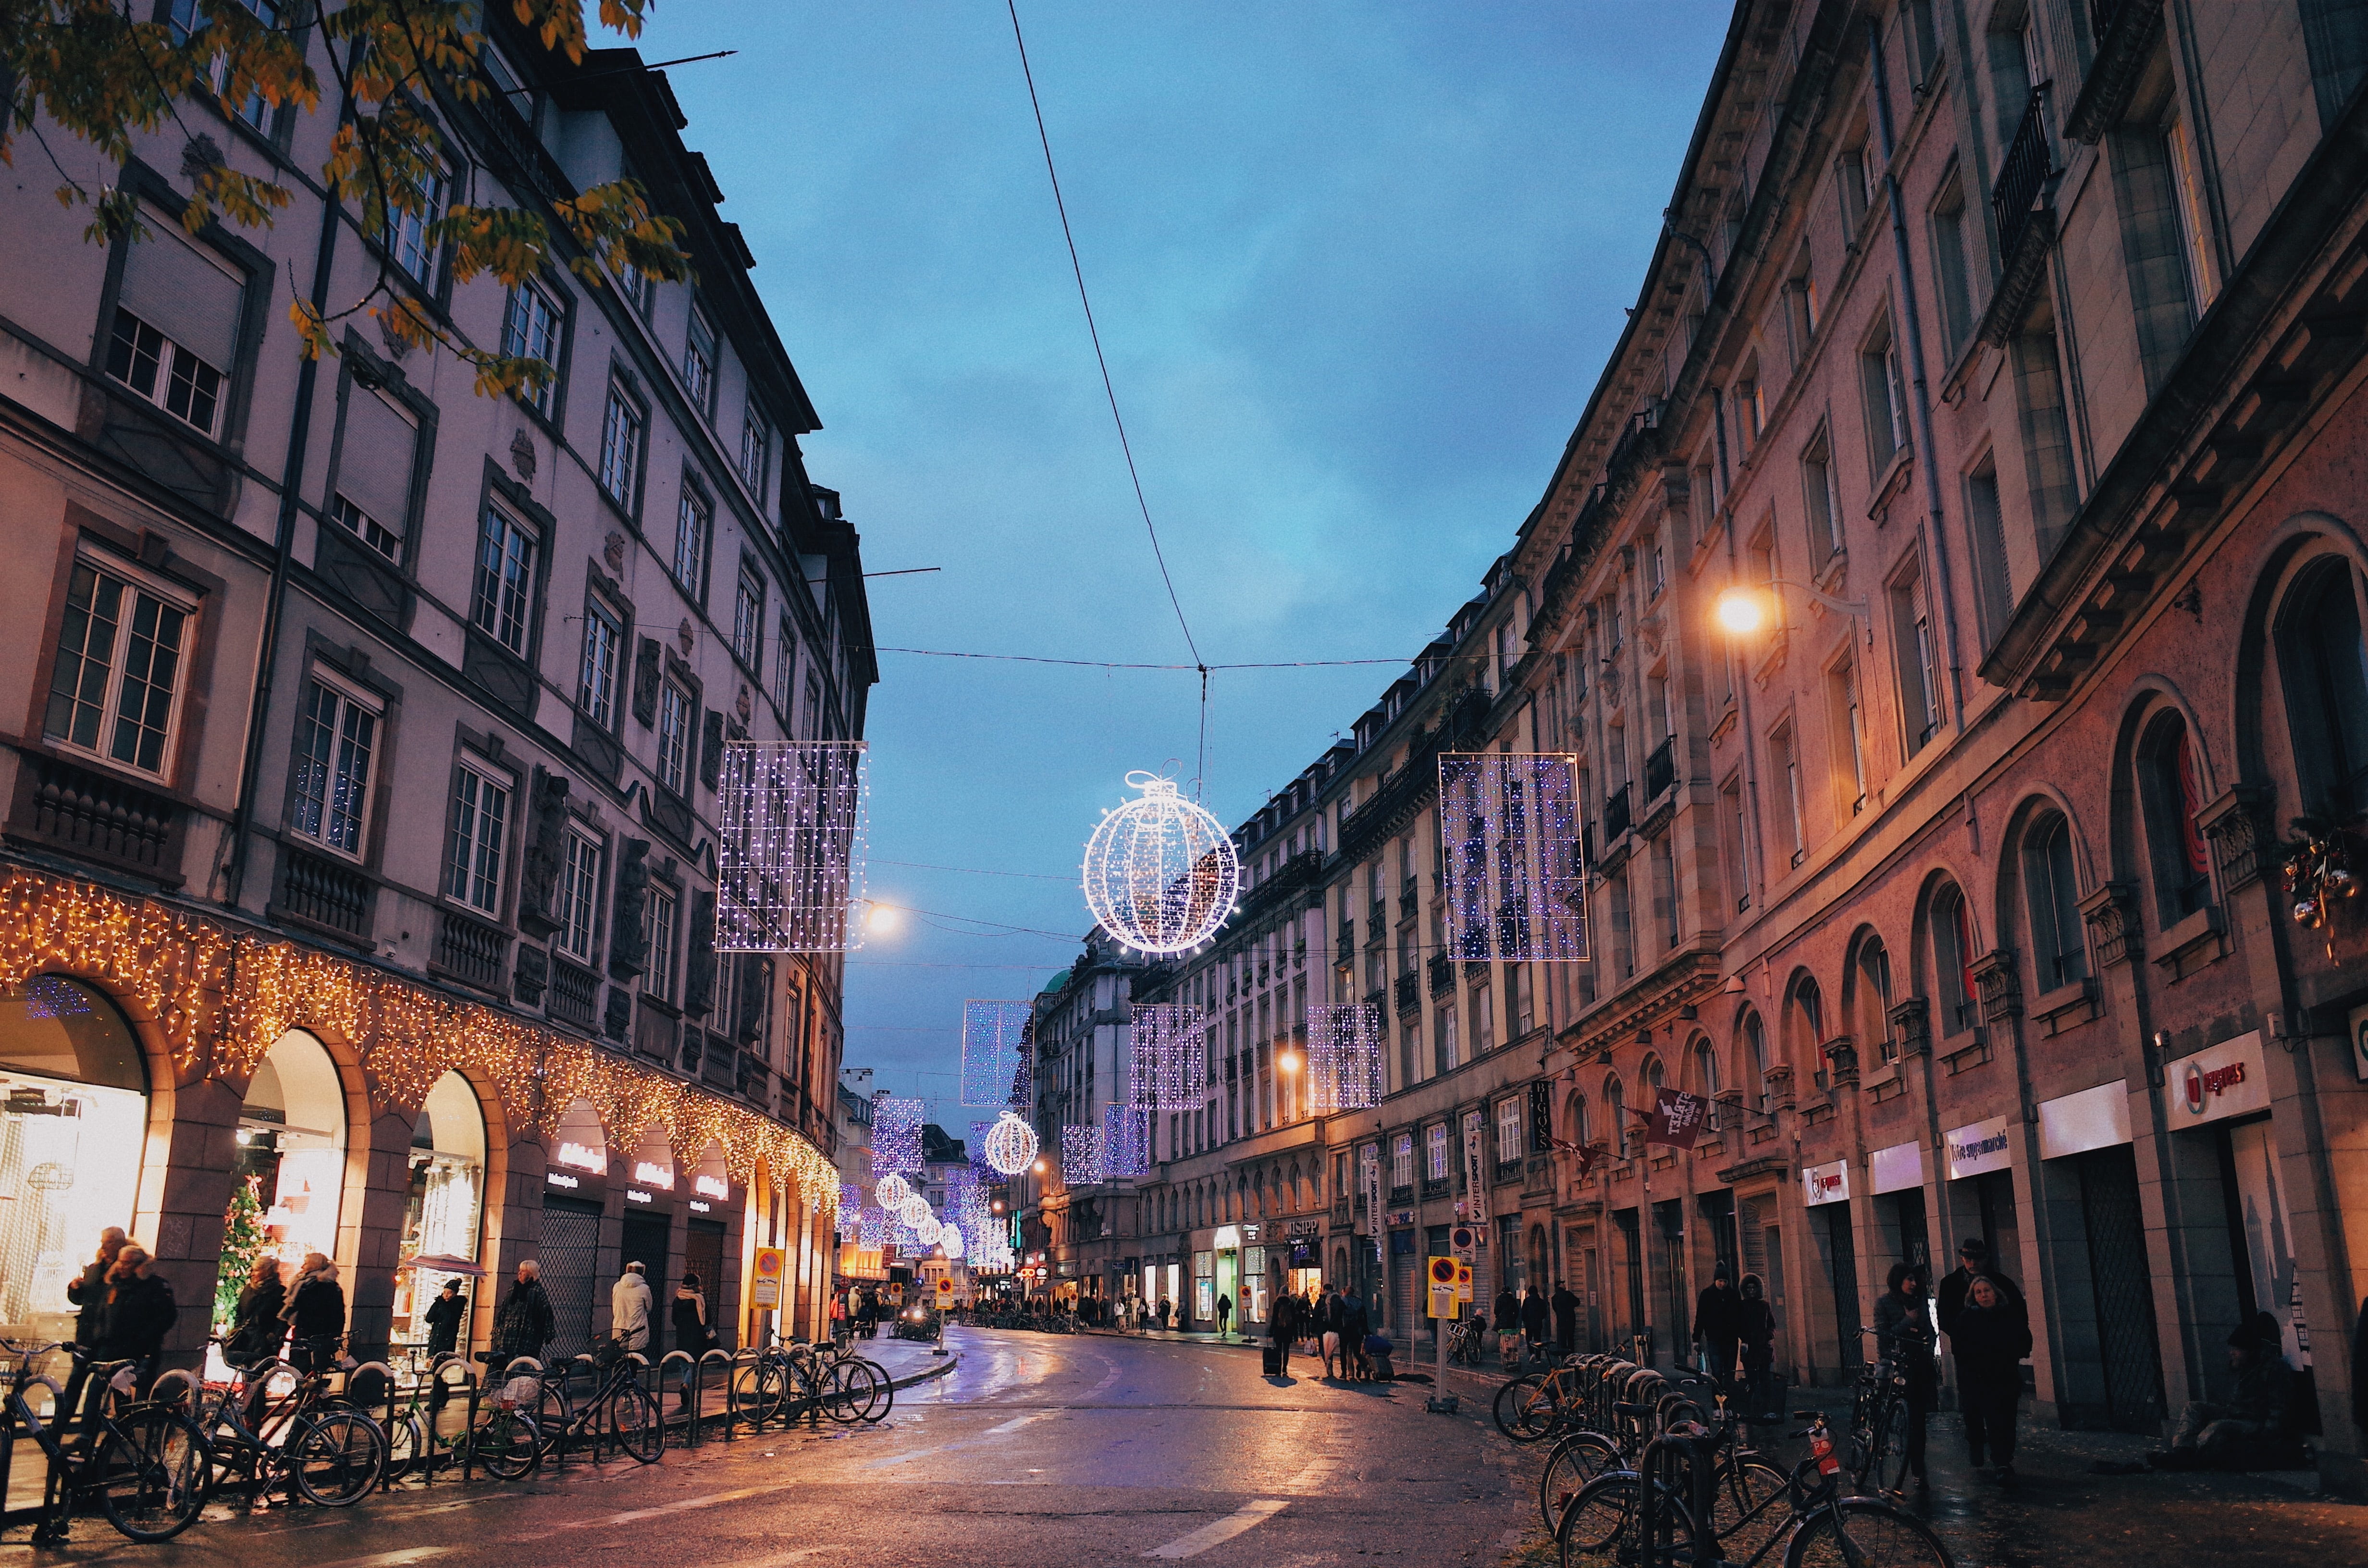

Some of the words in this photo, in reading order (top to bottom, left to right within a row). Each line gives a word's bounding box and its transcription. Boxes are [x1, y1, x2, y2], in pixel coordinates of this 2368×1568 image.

[1949, 1144, 1966, 1162] Votre
[1966, 1128, 2008, 1161] supermarché
[1470, 1153, 1481, 1209] INTERSPORT
